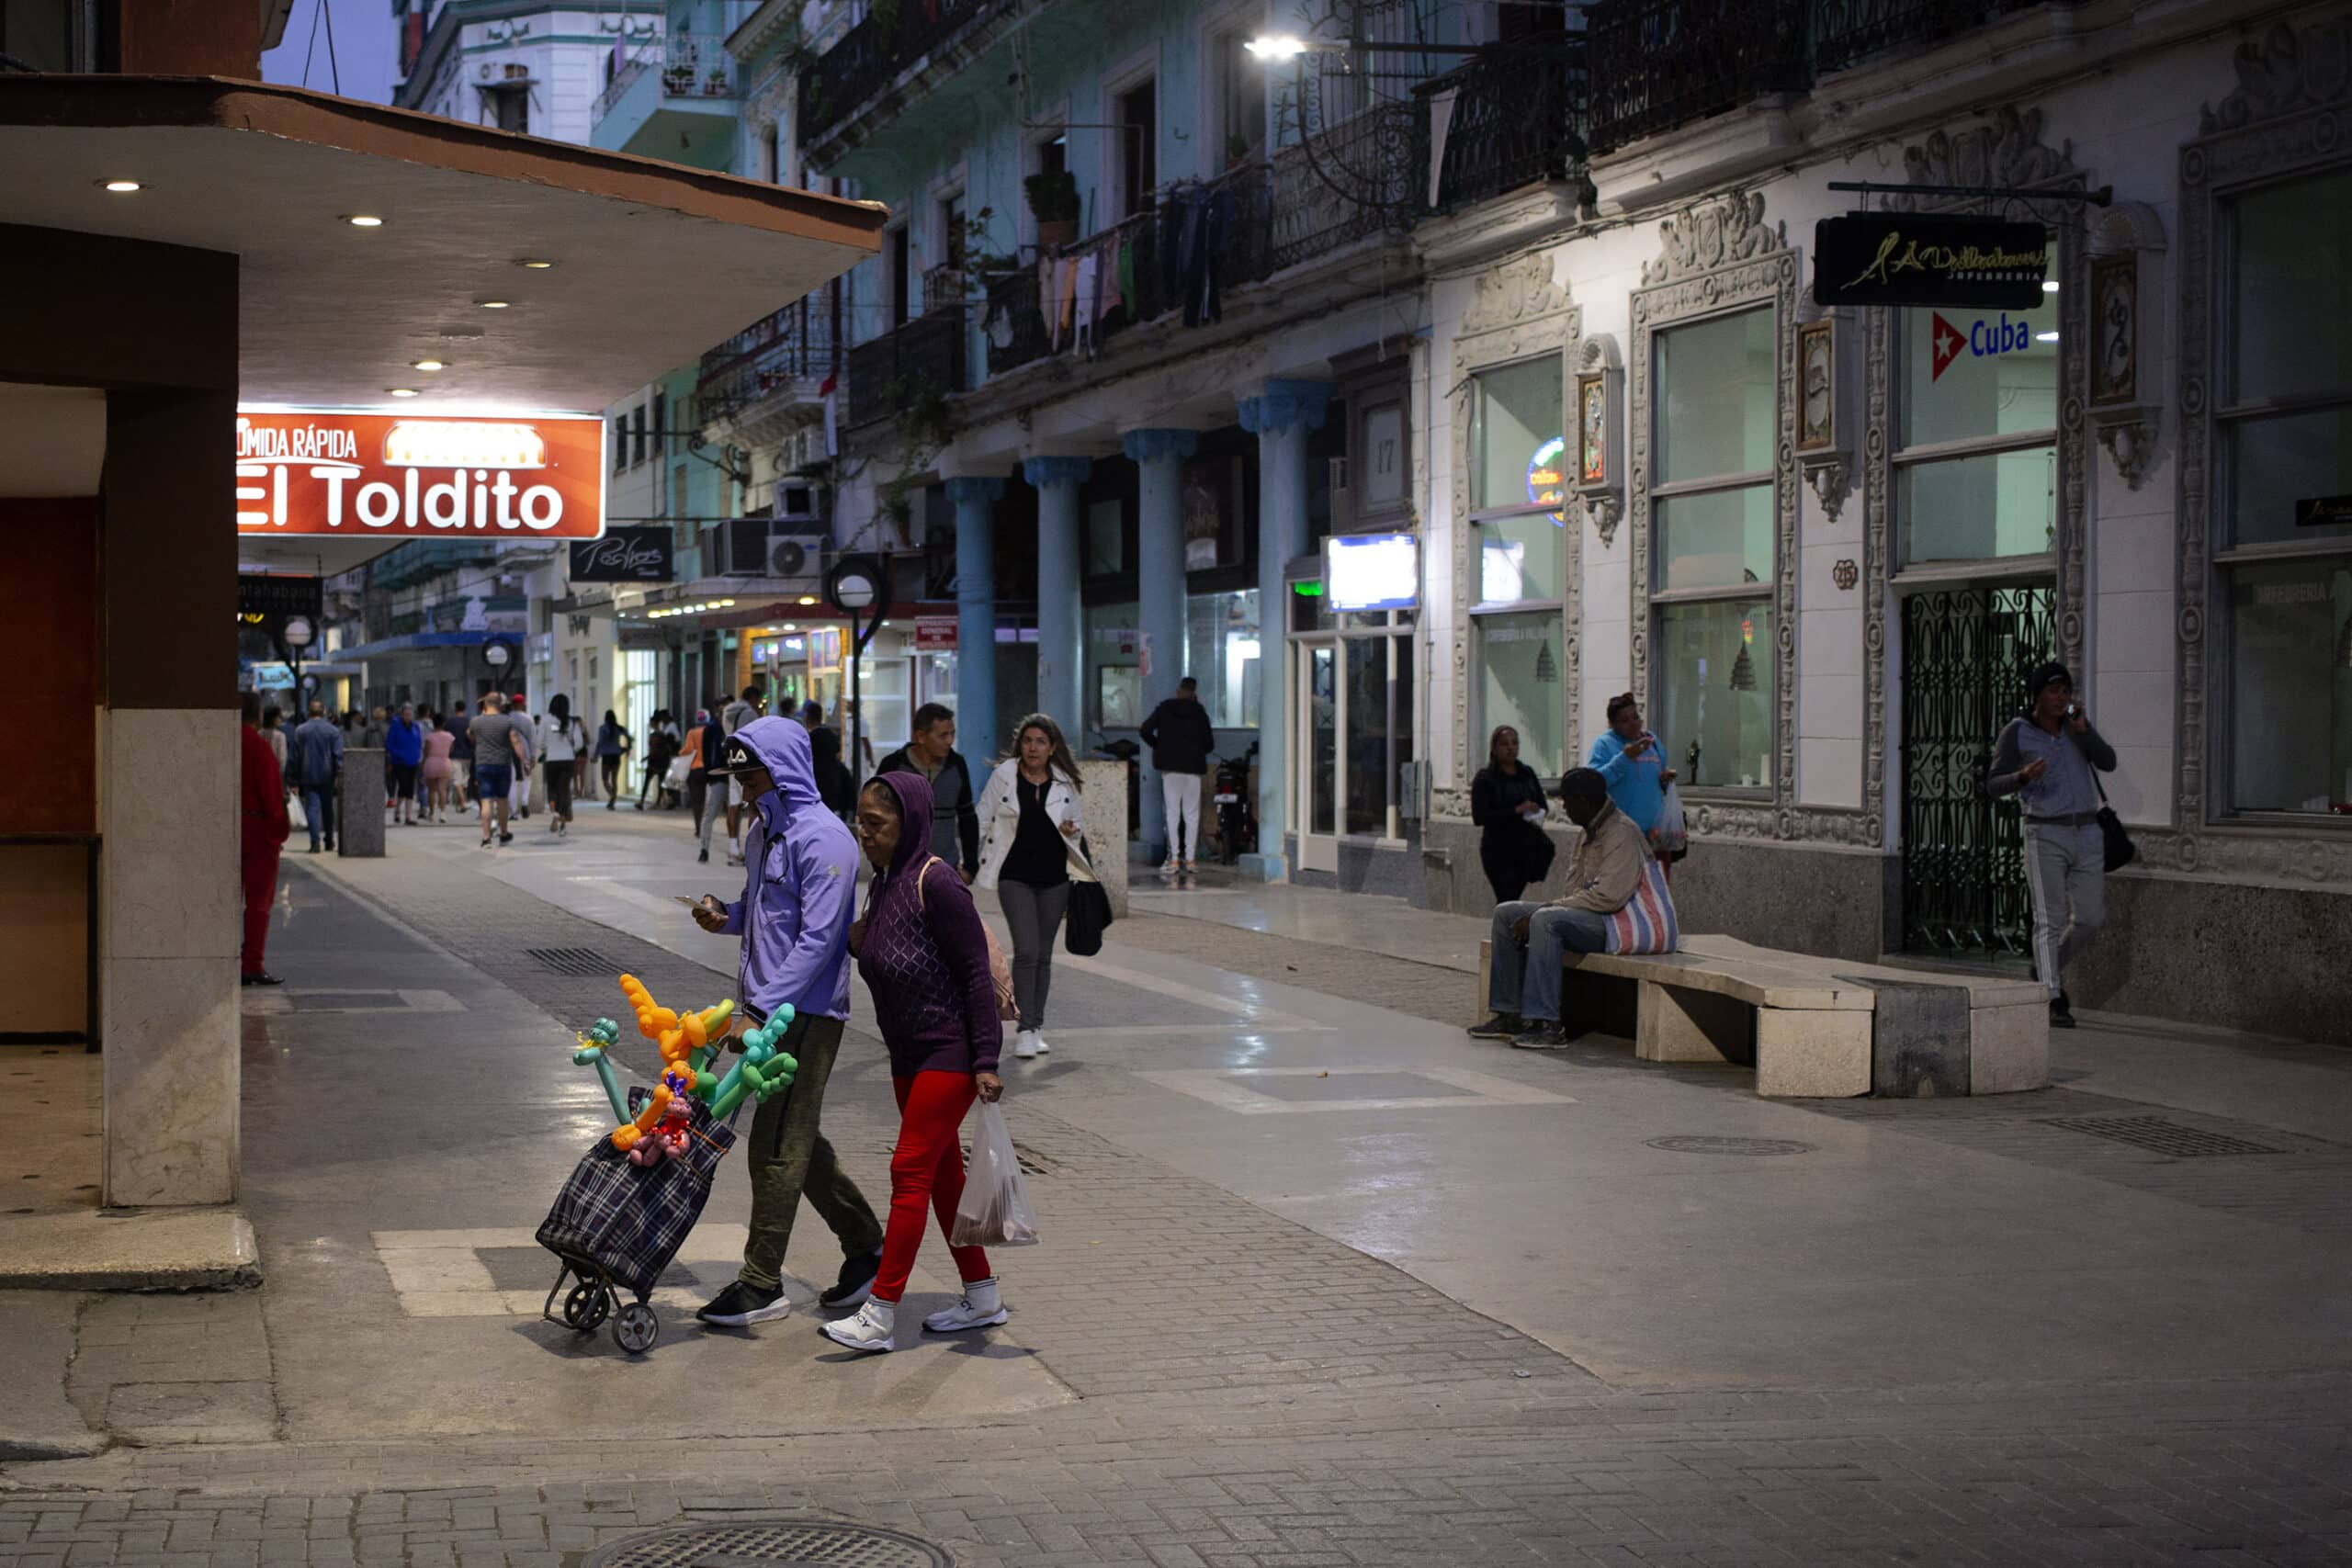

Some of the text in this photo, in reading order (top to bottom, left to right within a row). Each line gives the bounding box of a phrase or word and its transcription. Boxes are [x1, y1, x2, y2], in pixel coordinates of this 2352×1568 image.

[1971, 311, 2030, 357] Cuba
[236, 420, 358, 458] OMIDA RÁPIDA
[1377, 438, 1395, 475] 17
[310, 468, 563, 531] Toldito
